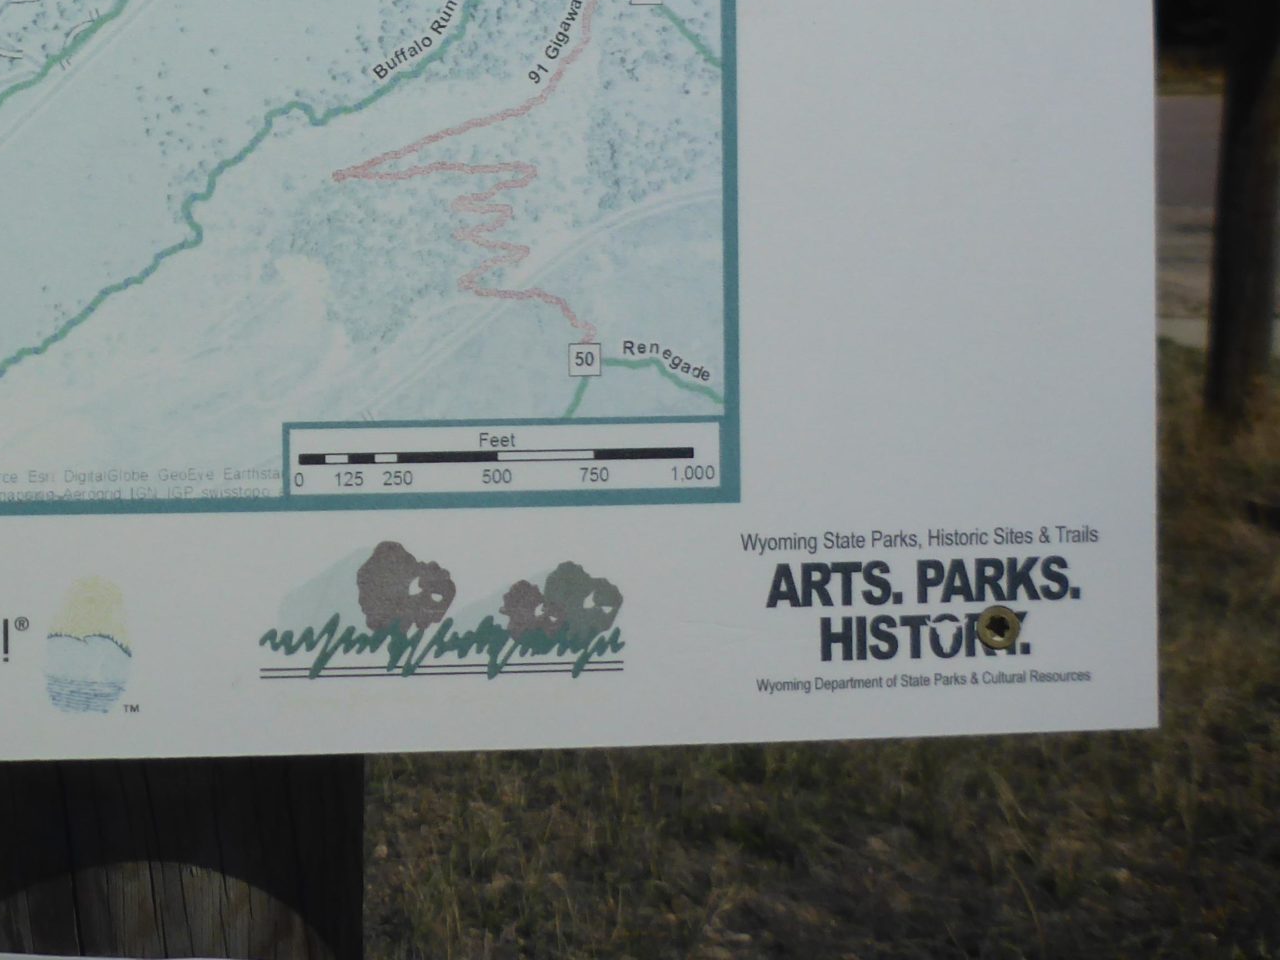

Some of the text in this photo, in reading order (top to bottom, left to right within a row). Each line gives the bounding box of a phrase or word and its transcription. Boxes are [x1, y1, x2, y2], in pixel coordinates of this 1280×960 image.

[373, 0, 458, 81] Buffalo Run
[528, 63, 549, 85] 91
[575, 351, 594, 367] 50
[622, 340, 711, 382] Renegade
[479, 432, 516, 447] Feet
[294, 465, 715, 488] 0 125 250 500 750 1,000
[741, 525, 1099, 555] Wyoming State Parks, Historic Sites & Trails
[766, 556, 1080, 608] ARTS. PARKS.
[756, 668, 1091, 694] Wyoming Department of State Parks & Cultural Resources
